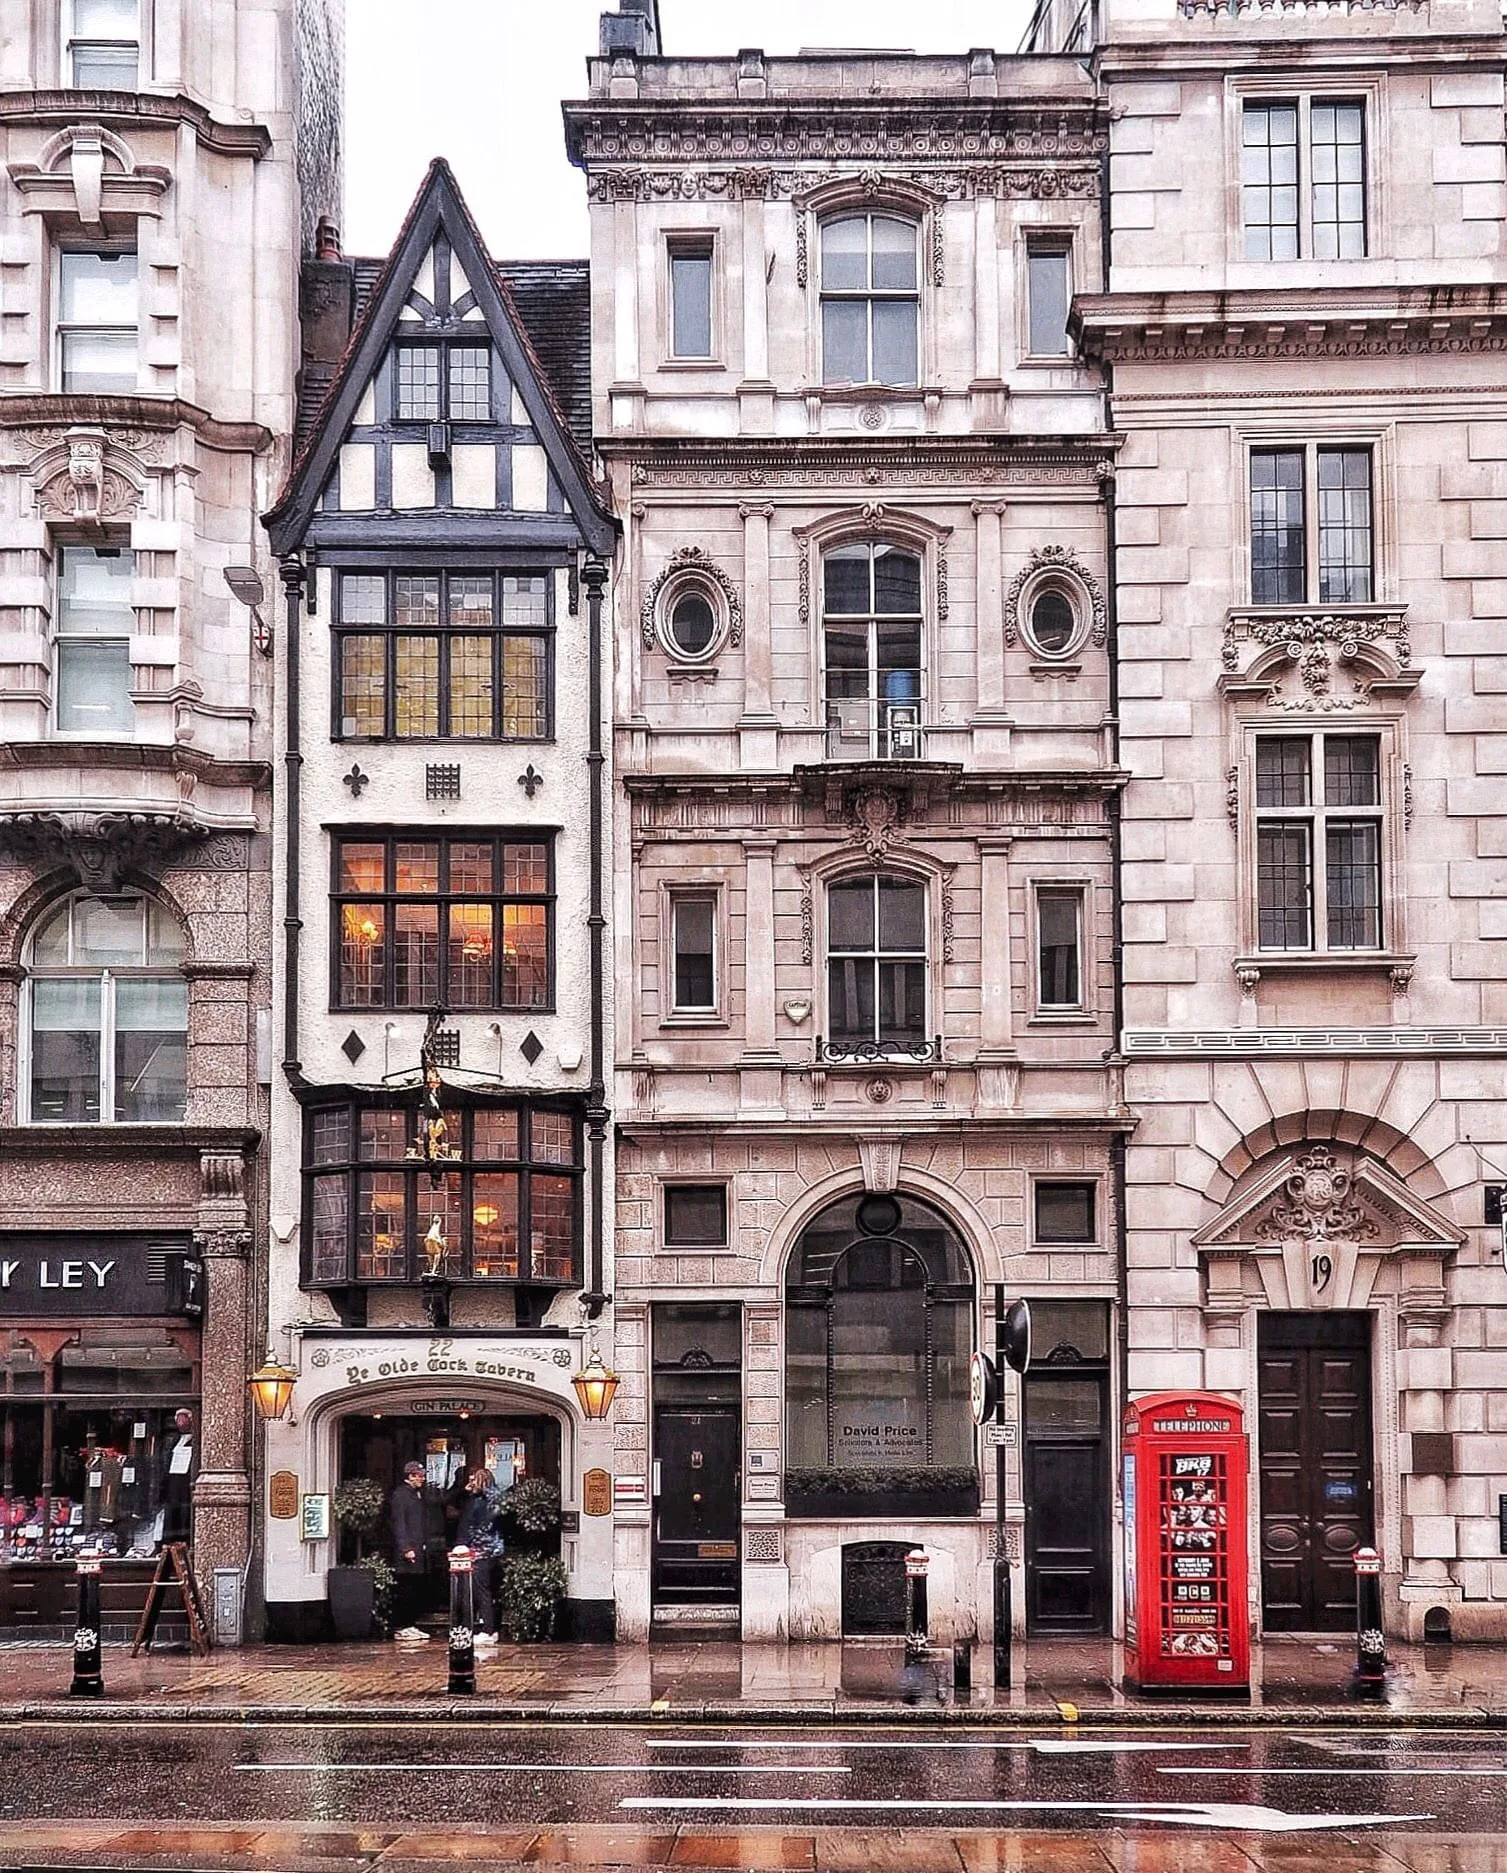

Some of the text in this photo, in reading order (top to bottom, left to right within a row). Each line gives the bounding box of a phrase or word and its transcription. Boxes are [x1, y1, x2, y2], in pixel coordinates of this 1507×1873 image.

[40, 1260, 116, 1288] LEY
[1311, 1255, 1332, 1294] 19
[428, 1338, 454, 1357] 22
[346, 1358, 536, 1385] Ye Olde Cock Tavern
[415, 1402, 481, 1411] GIN PALACE
[843, 1426, 917, 1436] David Price
[1156, 1420, 1229, 1432] TELEPHONE
